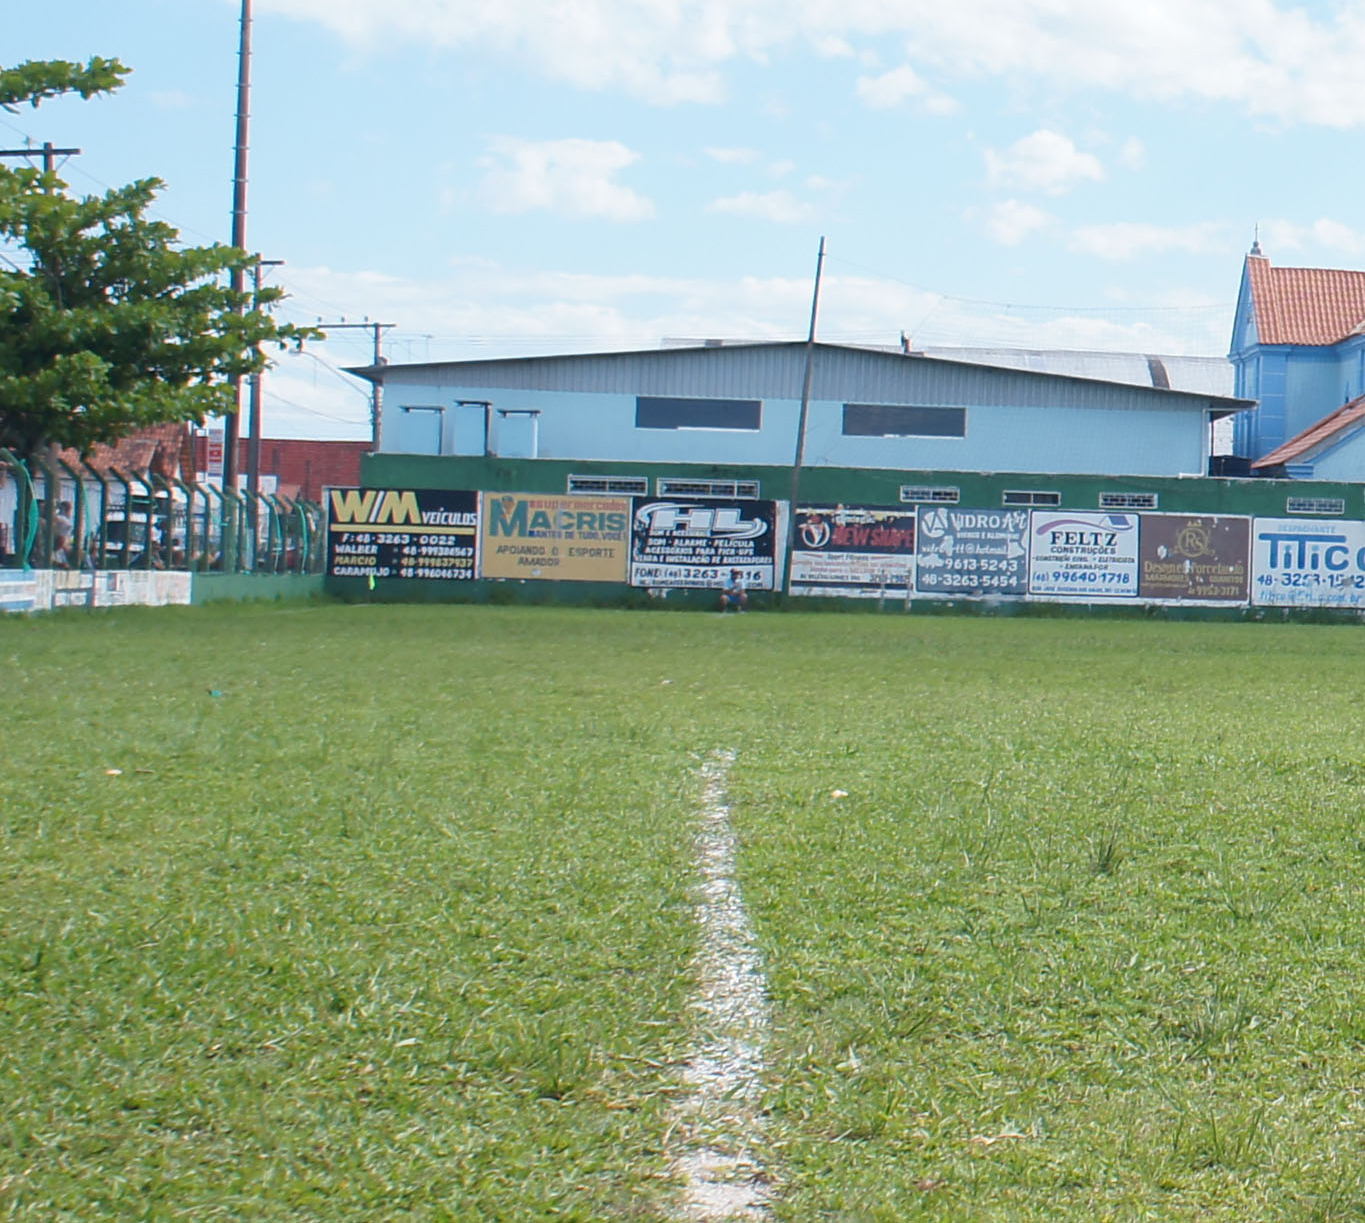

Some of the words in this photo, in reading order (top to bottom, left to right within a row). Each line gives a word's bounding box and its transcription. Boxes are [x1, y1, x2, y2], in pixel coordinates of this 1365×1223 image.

[422, 507, 477, 526] VEÍCULOS
[1050, 531, 1118, 546] FELTZ
[335, 545, 378, 554] WALBER
[496, 545, 546, 555] APOIANDO
[552, 547, 558, 556] O
[568, 547, 615, 558] ESPORTE
[1050, 545, 1116, 555] CONSTRUÇÕES
[517, 557, 560, 566] AMADOR
